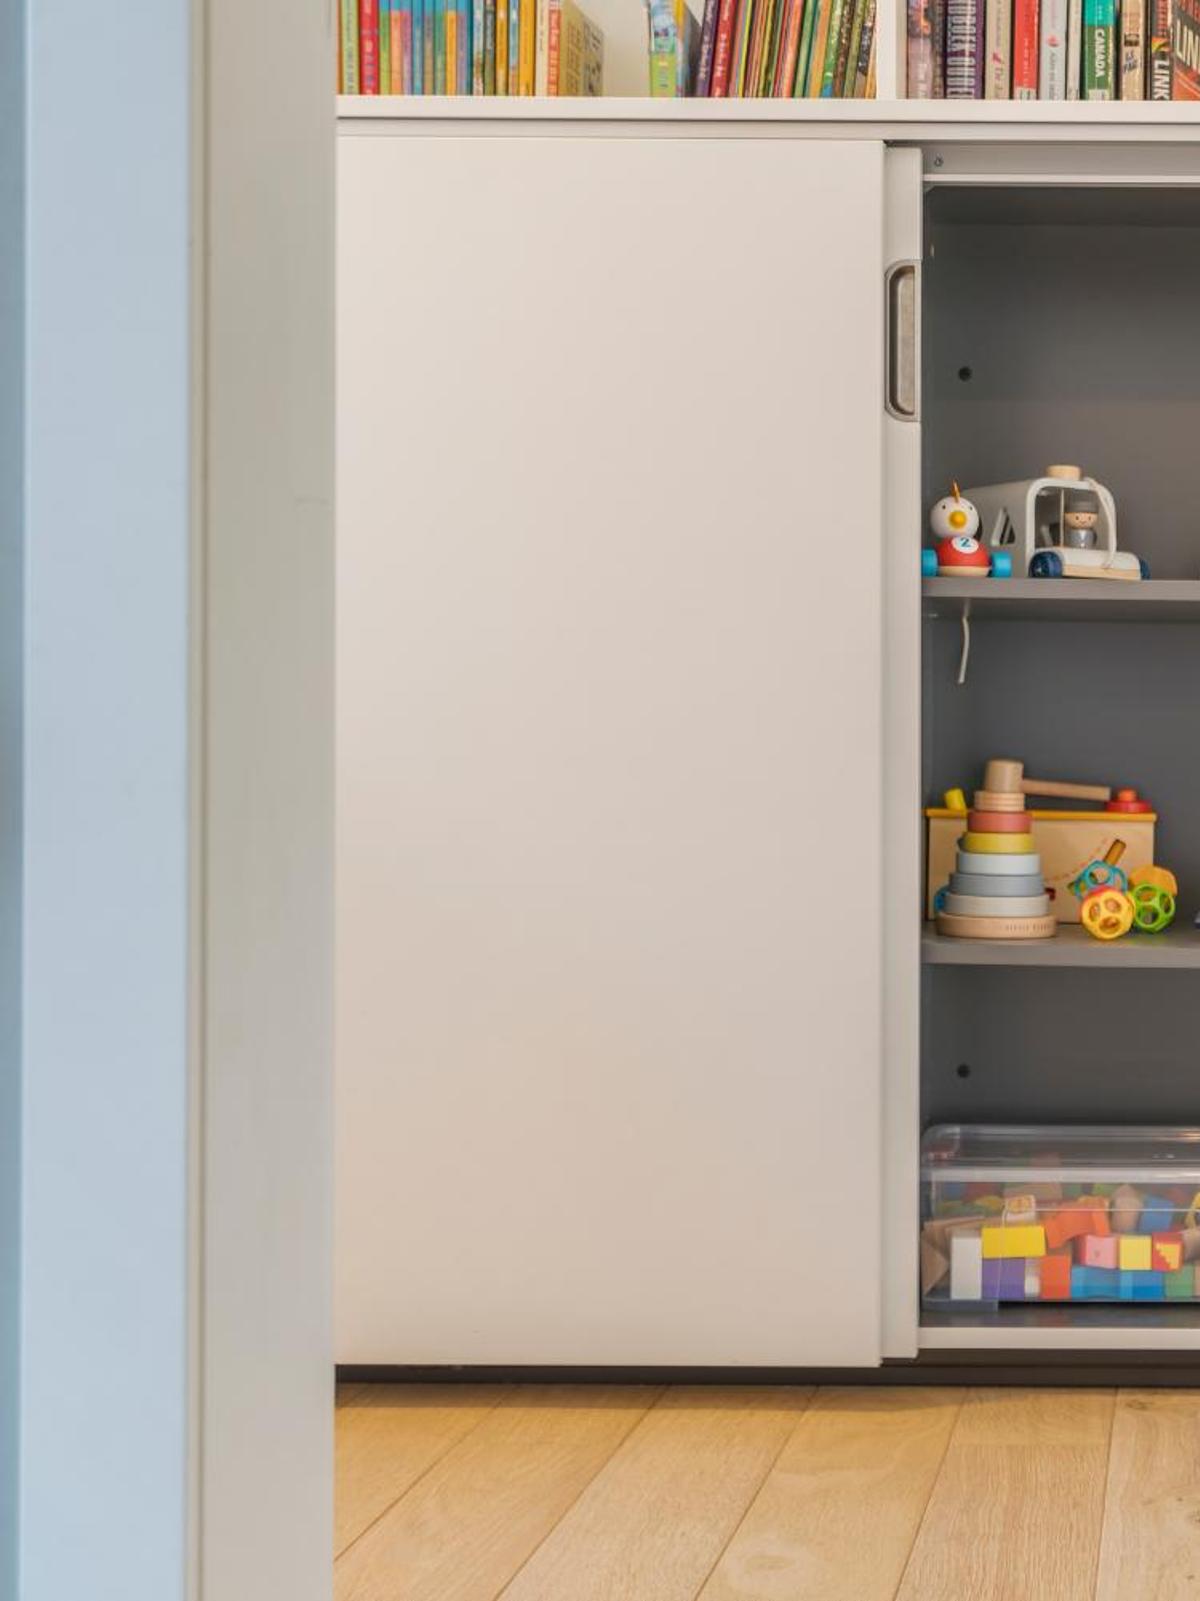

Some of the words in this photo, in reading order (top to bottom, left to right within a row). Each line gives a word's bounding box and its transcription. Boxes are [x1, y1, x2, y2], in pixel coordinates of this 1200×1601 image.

[1094, 28, 1106, 77] CANADA
[1153, 60, 1170, 100] LINK
[959, 536, 972, 548] 2
